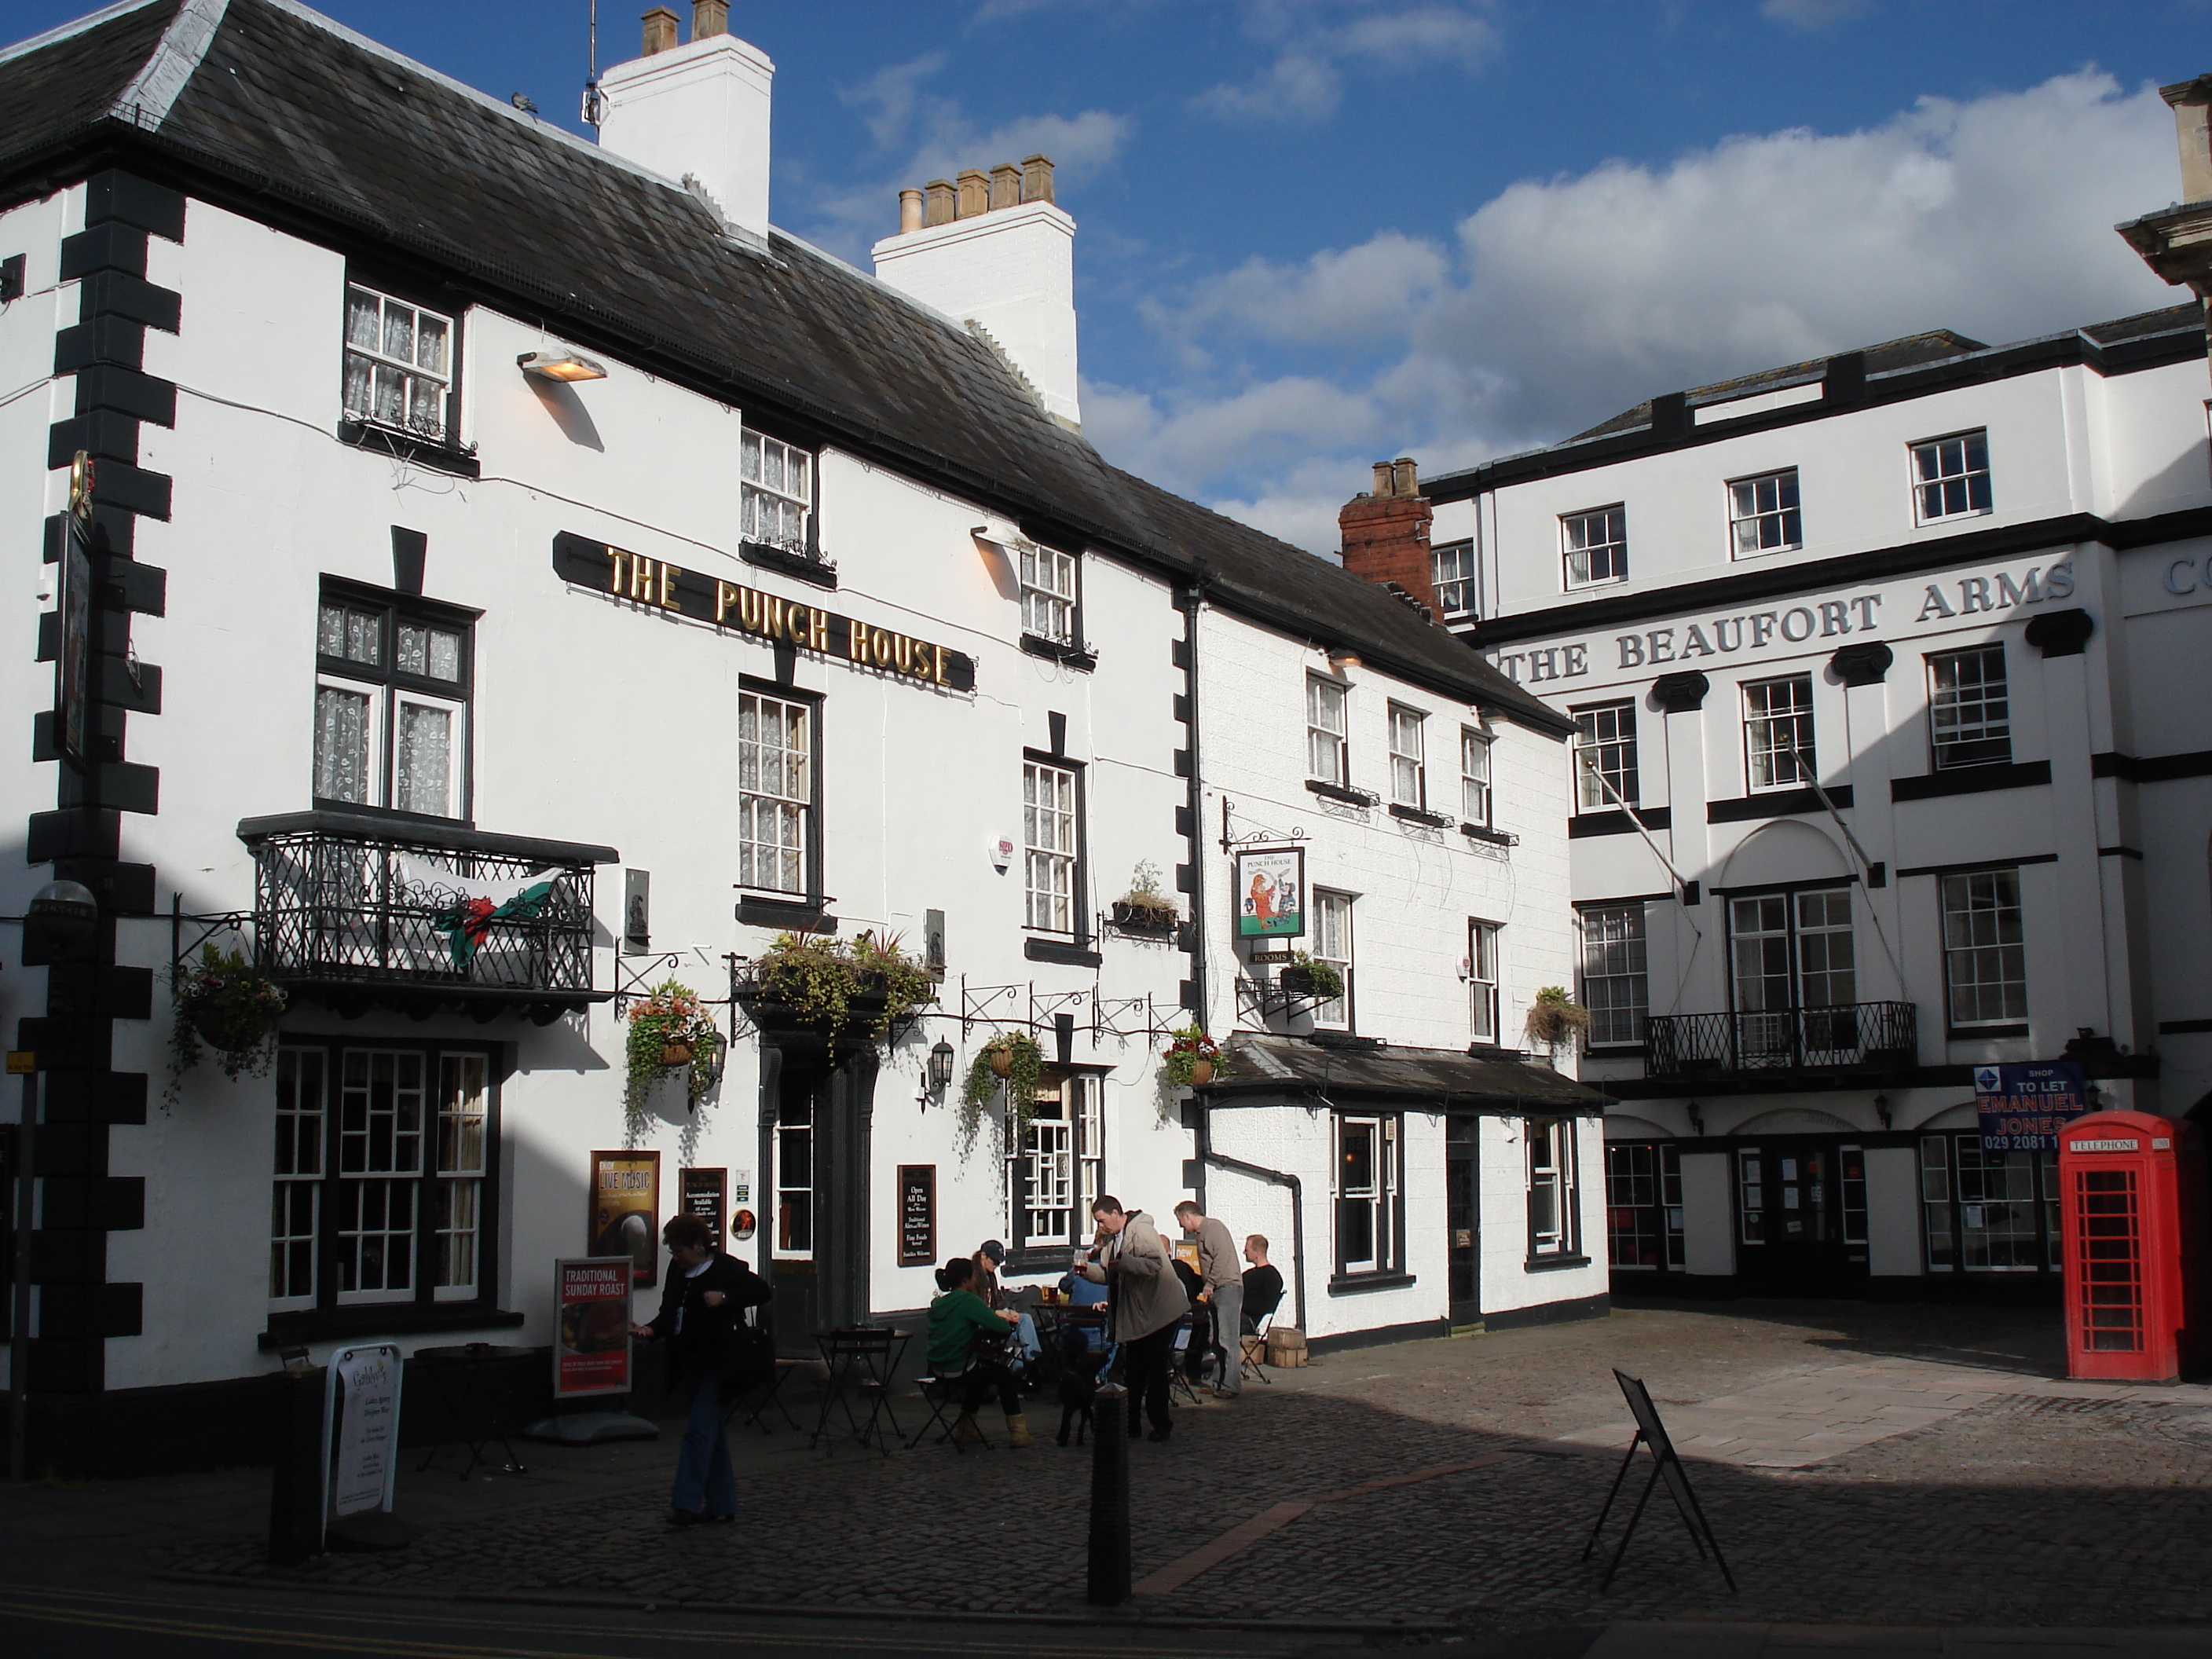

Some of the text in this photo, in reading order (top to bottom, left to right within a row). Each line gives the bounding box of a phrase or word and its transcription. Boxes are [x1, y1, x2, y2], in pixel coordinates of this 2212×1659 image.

[607, 546, 952, 687] THE PUNCH HOUSE
[1500, 562, 2075, 685] THE BEAUFORT ARMS
[1254, 953, 1287, 962] ROOMS
[2029, 1069, 2054, 1078] SHOP
[2016, 1080, 2067, 1093] TO LET
[1977, 1093, 2084, 1114] EMANUEL
[1996, 1116, 2067, 1136] JONES
[1984, 1135, 2009, 1149] 029
[2012, 1135, 2045, 1149] 2081
[2075, 1140, 2137, 1151] TELEPHONE
[599, 1170, 650, 1189] LIVE MUSIC
[910, 1186, 924, 1195] Open
[566, 1269, 618, 1283] TRADITIONAL
[565, 1283, 625, 1297] SUNDAY ROAST
